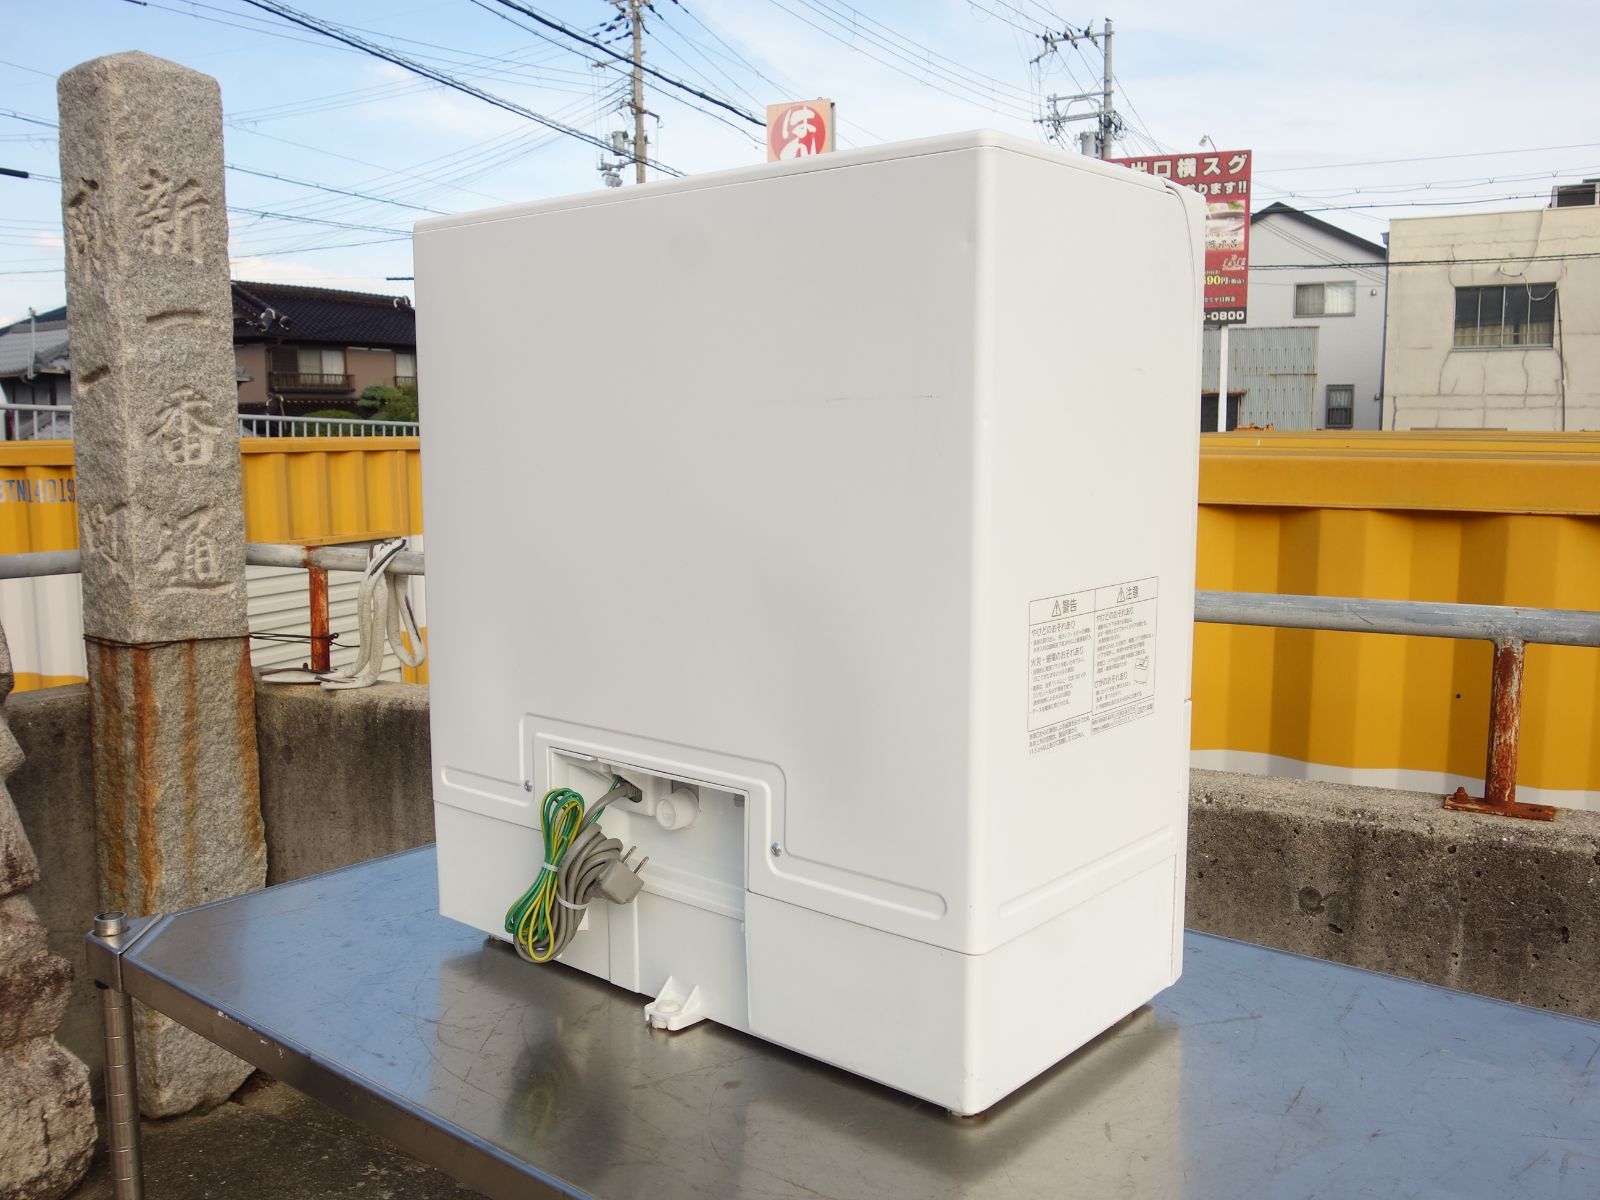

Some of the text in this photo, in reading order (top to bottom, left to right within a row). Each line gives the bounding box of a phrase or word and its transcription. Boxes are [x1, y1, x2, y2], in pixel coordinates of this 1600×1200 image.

[1130, 154, 1247, 178] 出口横スグ
[136, 167, 235, 593] 新一番通
[1125, 585, 1139, 600] 注意
[1062, 598, 1077, 615] 警告
[1096, 606, 1134, 622] やけどのおそれあり
[1031, 620, 1076, 637] やけどのおそれあり
